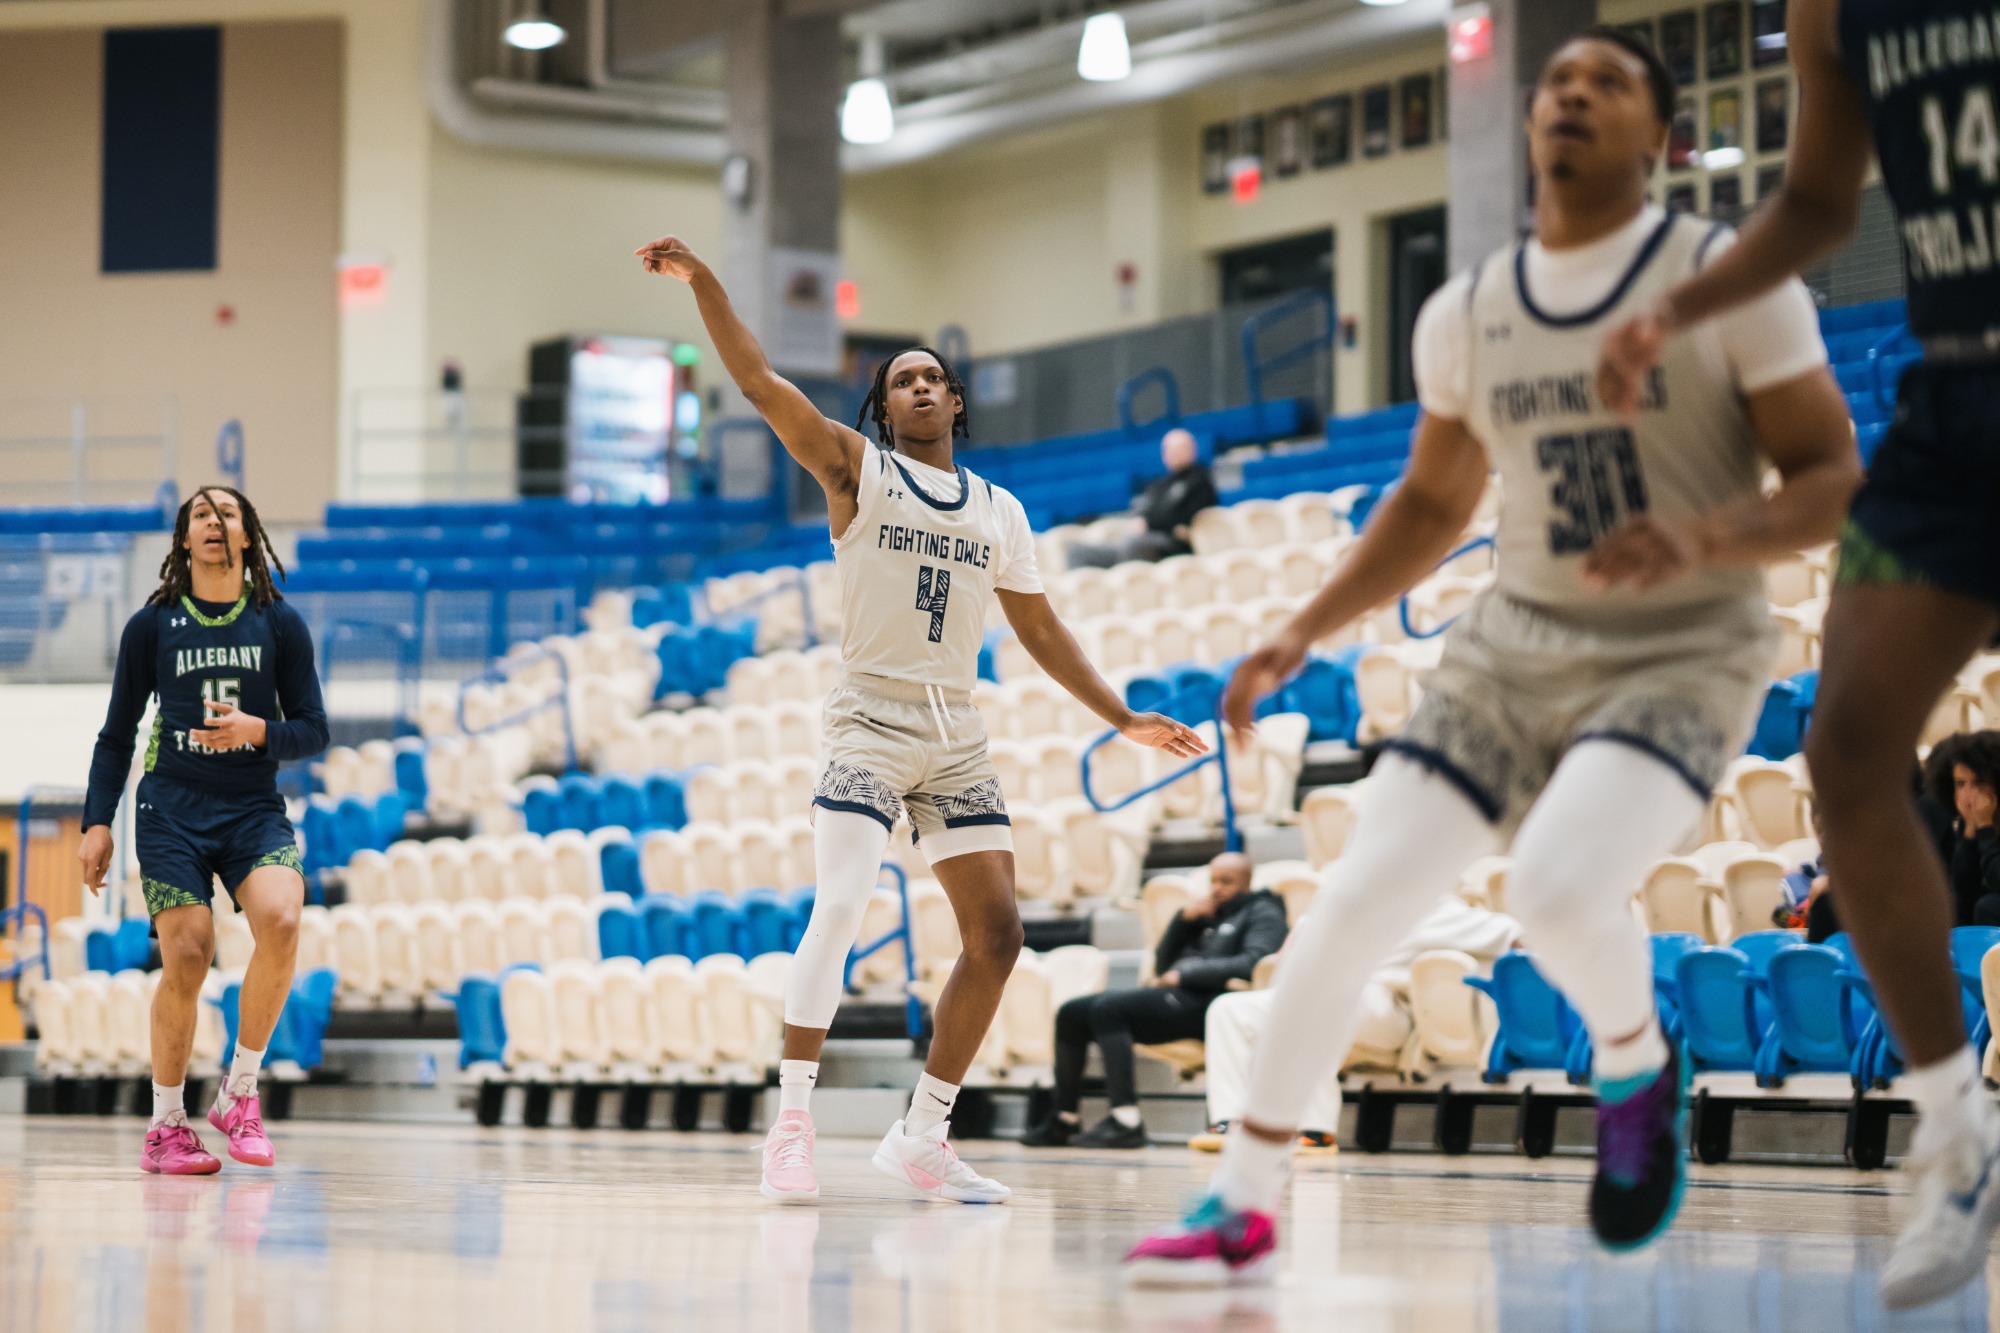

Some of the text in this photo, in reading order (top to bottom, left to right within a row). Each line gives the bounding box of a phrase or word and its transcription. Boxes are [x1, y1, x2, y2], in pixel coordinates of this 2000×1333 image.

[1922, 86, 2000, 194] 14
[878, 524, 990, 570] FIGHTING OWLS
[915, 565, 950, 643] 4
[176, 645, 262, 678] ALLEGANY
[201, 678, 241, 721] 15
